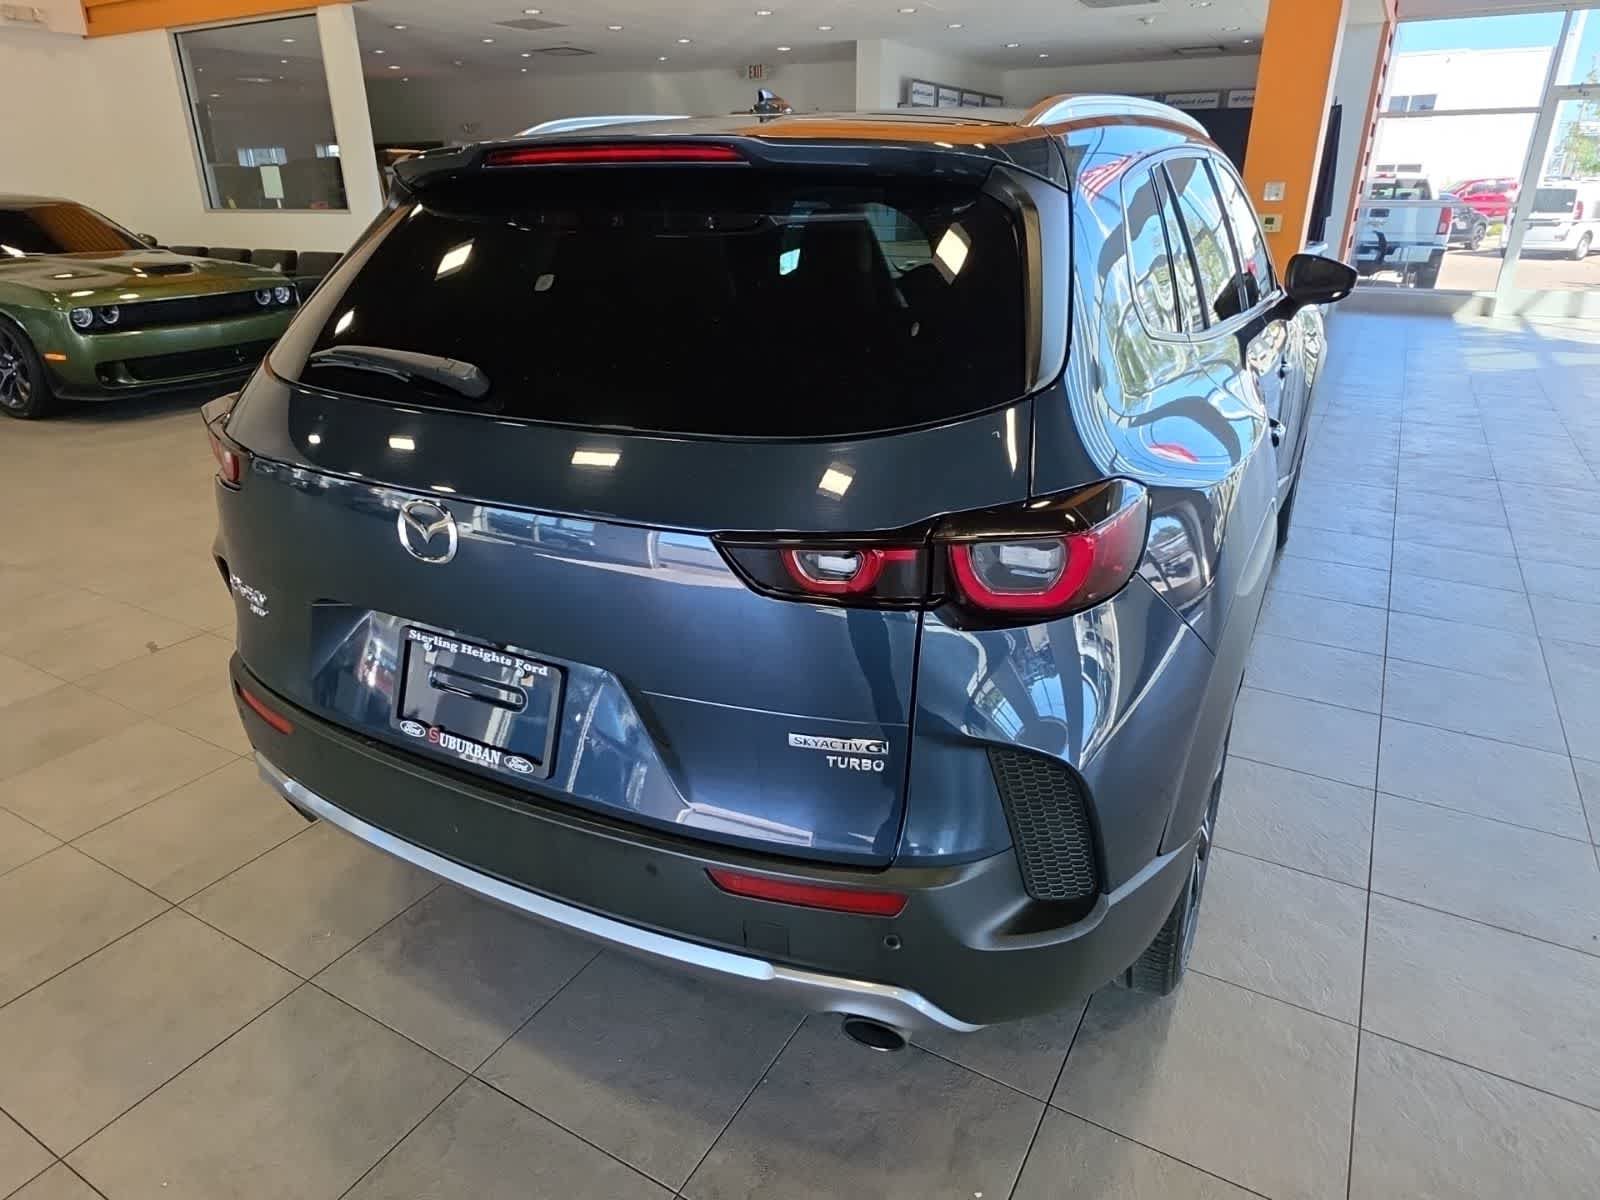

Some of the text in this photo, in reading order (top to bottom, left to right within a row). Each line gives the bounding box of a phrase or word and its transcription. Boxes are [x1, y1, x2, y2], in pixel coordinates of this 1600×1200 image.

[748, 64, 764, 80] EXIT
[408, 629, 549, 677] Sterling Heights Ford
[428, 727, 501, 765] SUBURBAN
[826, 755, 885, 772] TURBO
